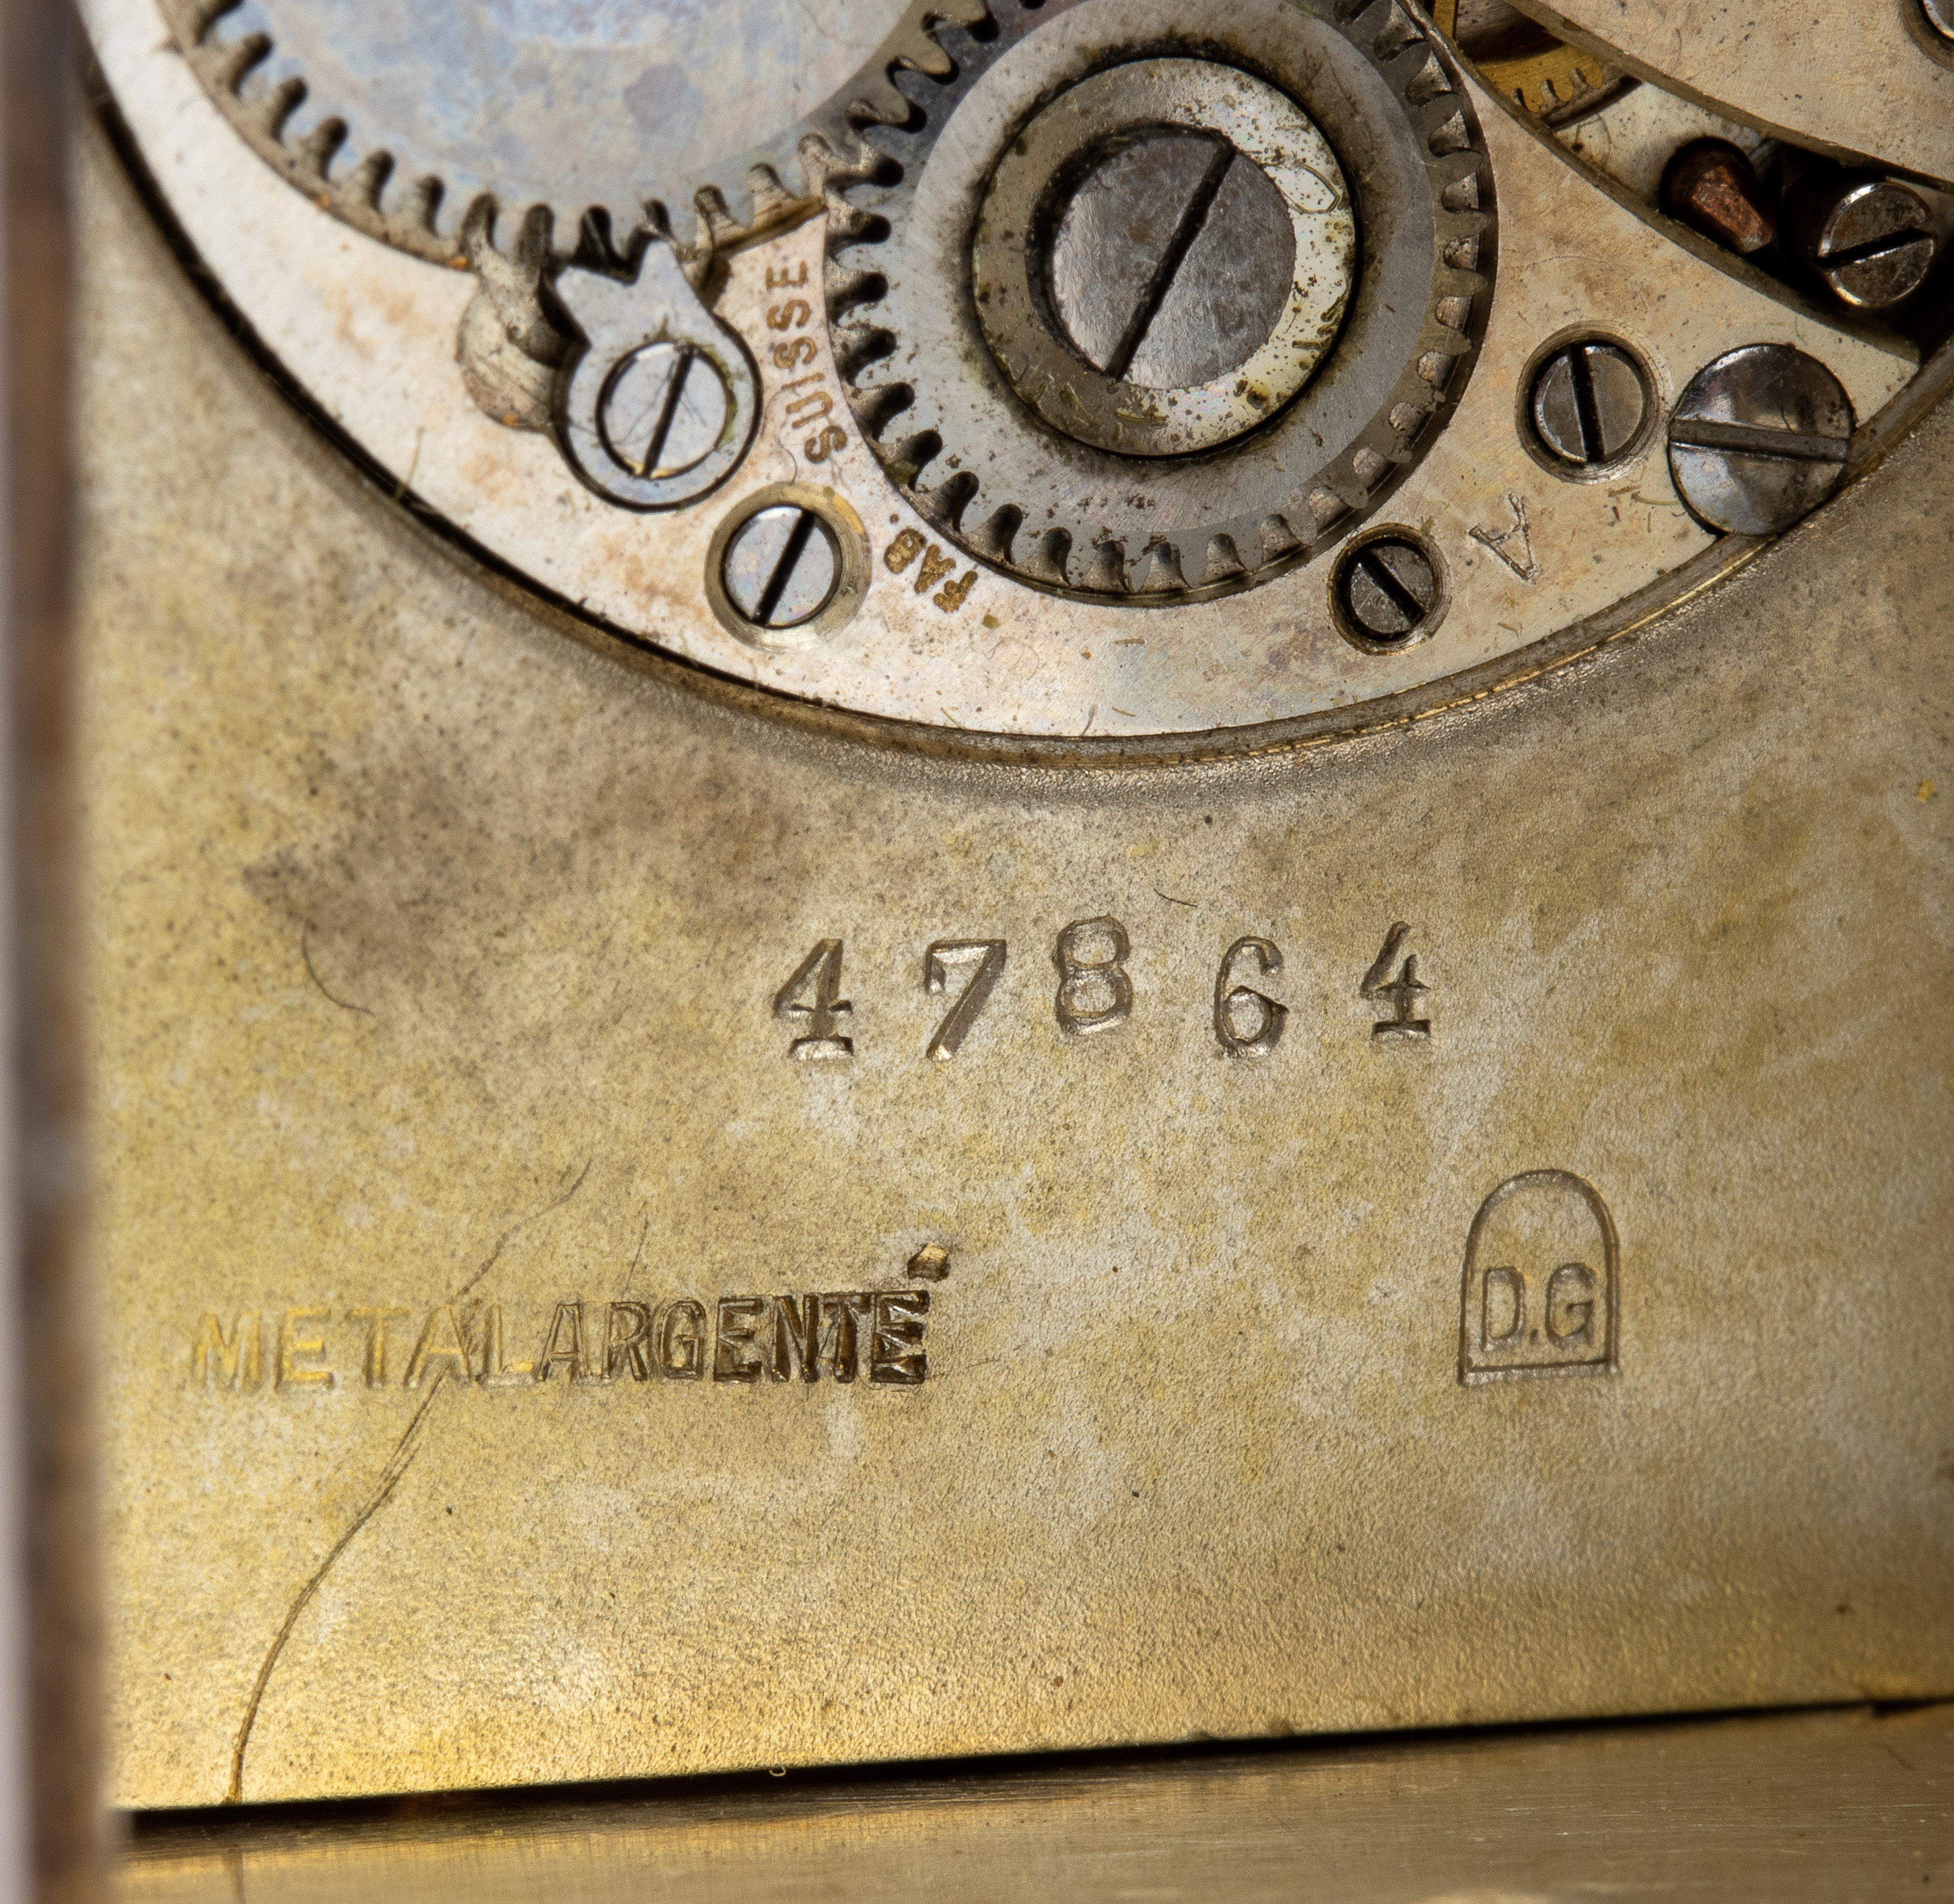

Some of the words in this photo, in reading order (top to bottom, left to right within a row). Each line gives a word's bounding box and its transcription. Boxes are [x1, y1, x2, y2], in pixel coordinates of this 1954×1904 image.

[765, 260, 848, 464] SUISSE
[1467, 490, 1540, 581] A
[773, 914, 1432, 1062] 47864
